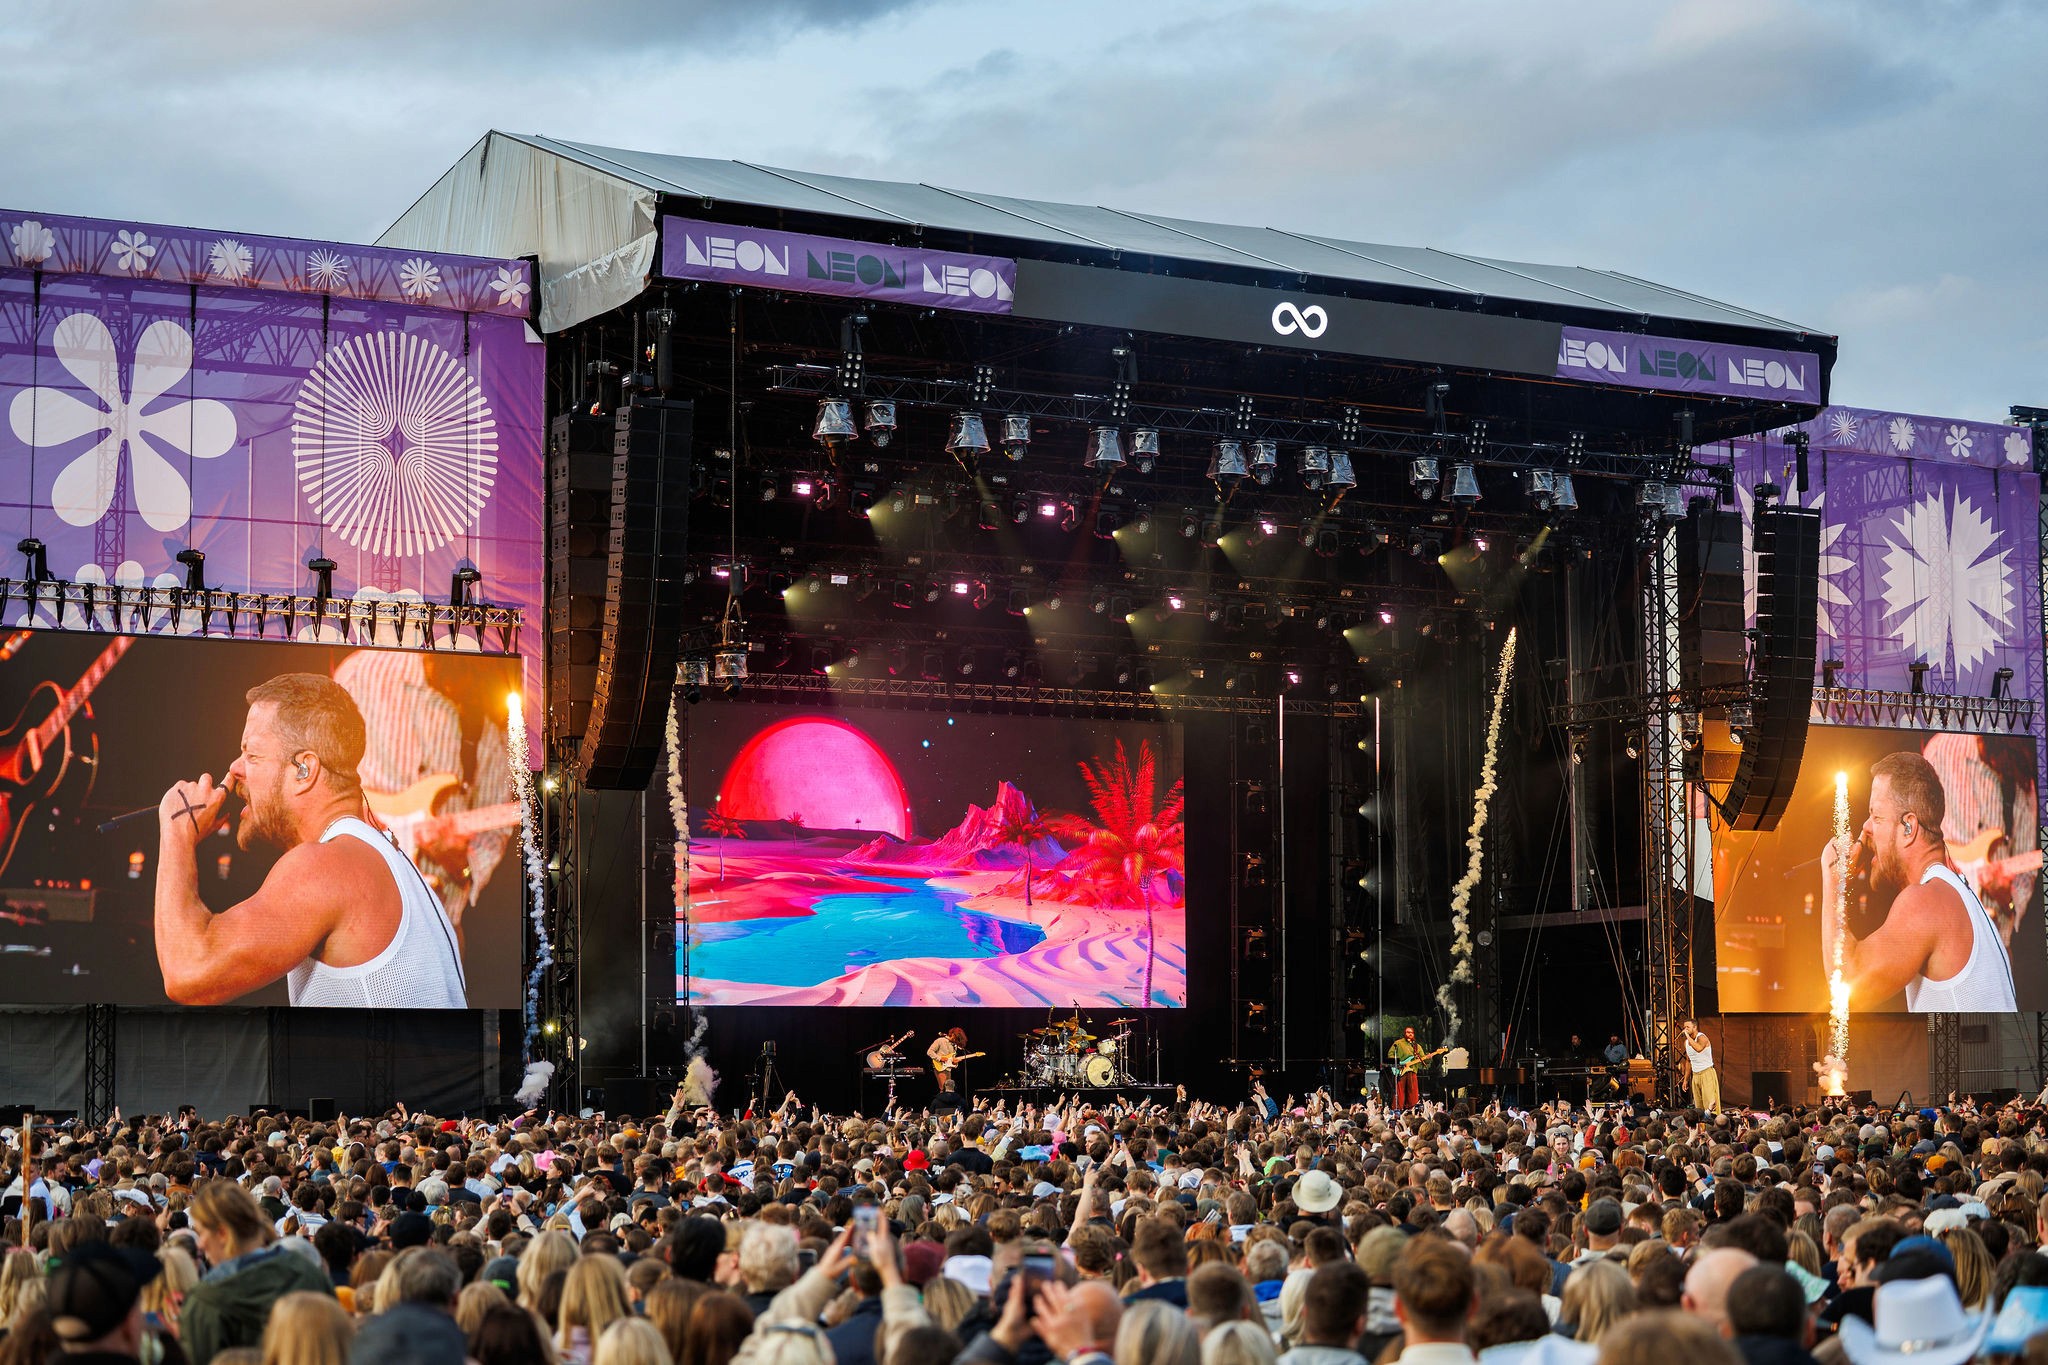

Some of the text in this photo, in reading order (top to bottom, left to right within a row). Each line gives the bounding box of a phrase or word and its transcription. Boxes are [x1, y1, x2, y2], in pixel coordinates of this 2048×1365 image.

[685, 233, 789, 276] NEON
[807, 248, 906, 289] NEON
[1639, 349, 1717, 381] NEON
[1728, 357, 1805, 391] NEON
